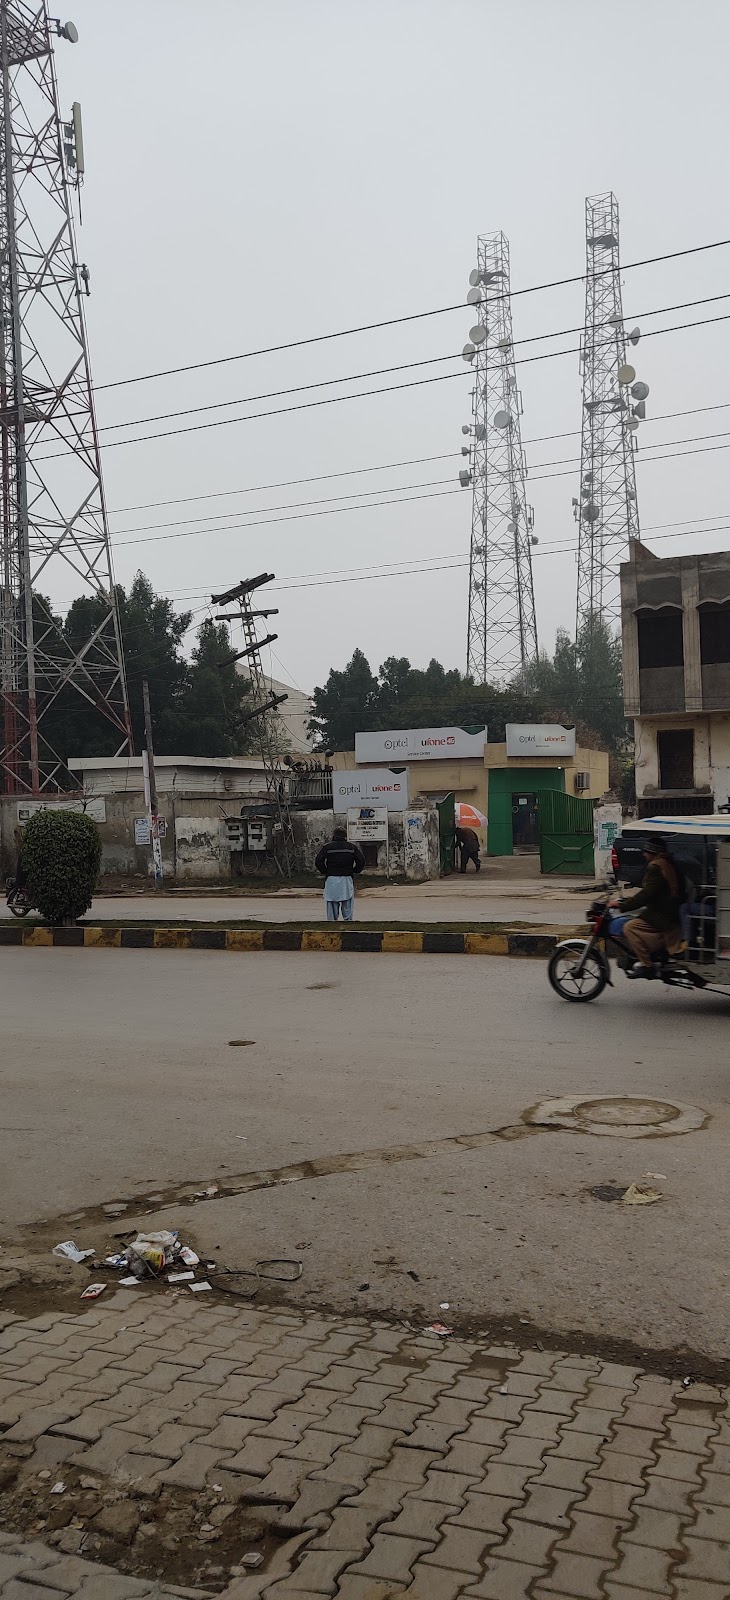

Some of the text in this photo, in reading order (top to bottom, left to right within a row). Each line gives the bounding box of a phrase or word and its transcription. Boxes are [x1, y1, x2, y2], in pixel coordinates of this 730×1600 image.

[392, 736, 455, 750] ptcl ufone 4G
[346, 783, 361, 795] ptcl
[372, 784, 393, 792] ufone
